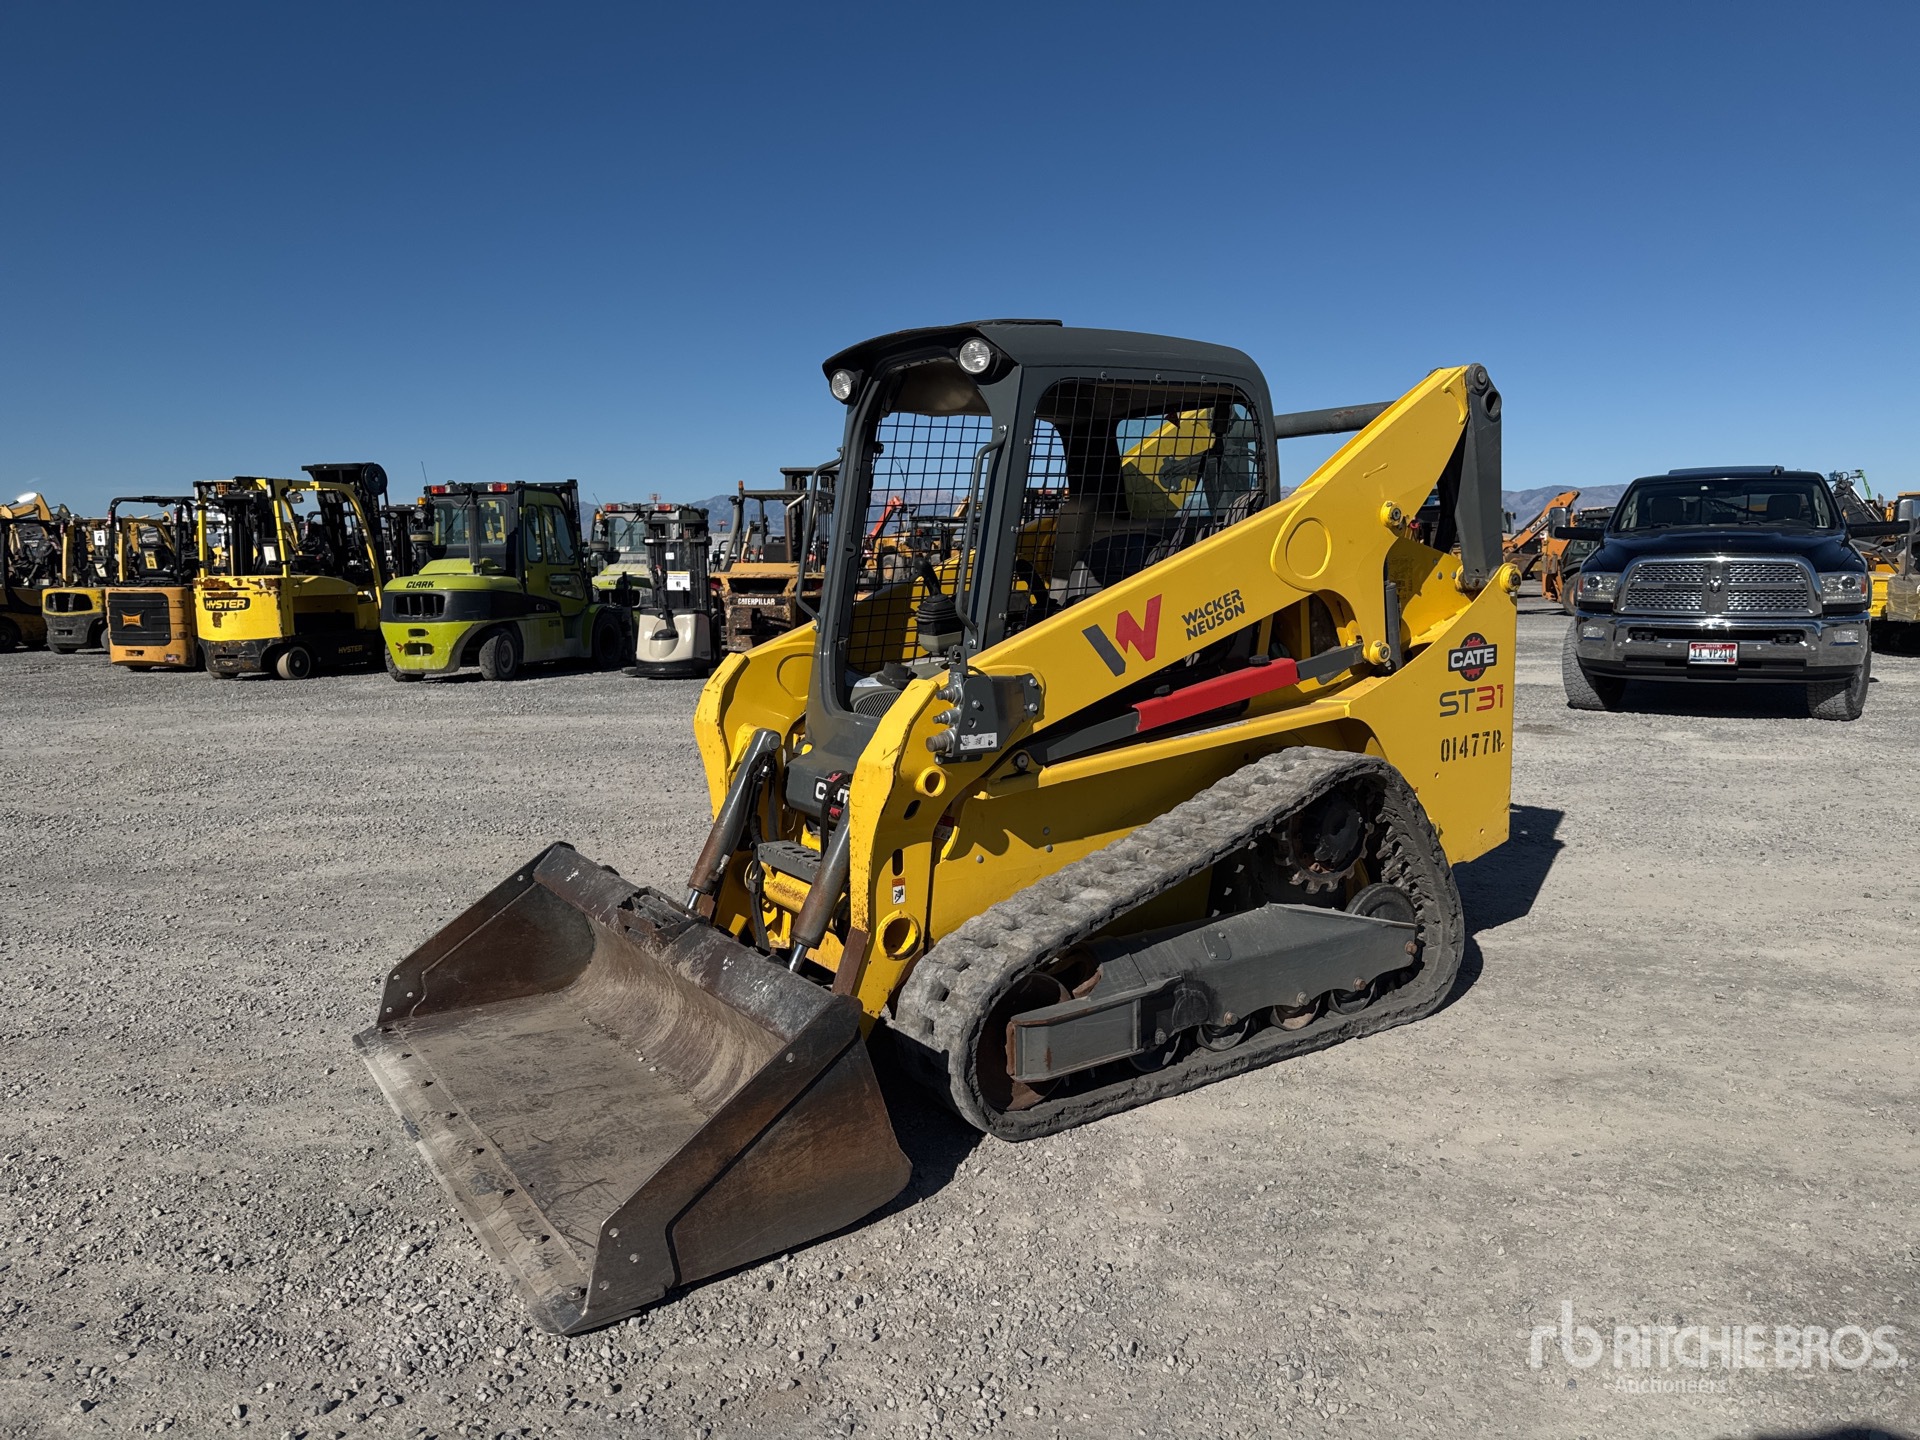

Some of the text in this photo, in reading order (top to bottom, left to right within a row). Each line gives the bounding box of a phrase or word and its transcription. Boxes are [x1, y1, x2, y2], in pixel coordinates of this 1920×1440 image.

[206, 599, 246, 609] HYSTER
[738, 597, 776, 606] CATERPILLAR
[1181, 589, 1243, 626] WACKER
[1185, 602, 1246, 641] NEUSON
[338, 645, 363, 654] HYSTER
[1451, 648, 1495, 668] CATE
[1439, 684, 1504, 717] ST31
